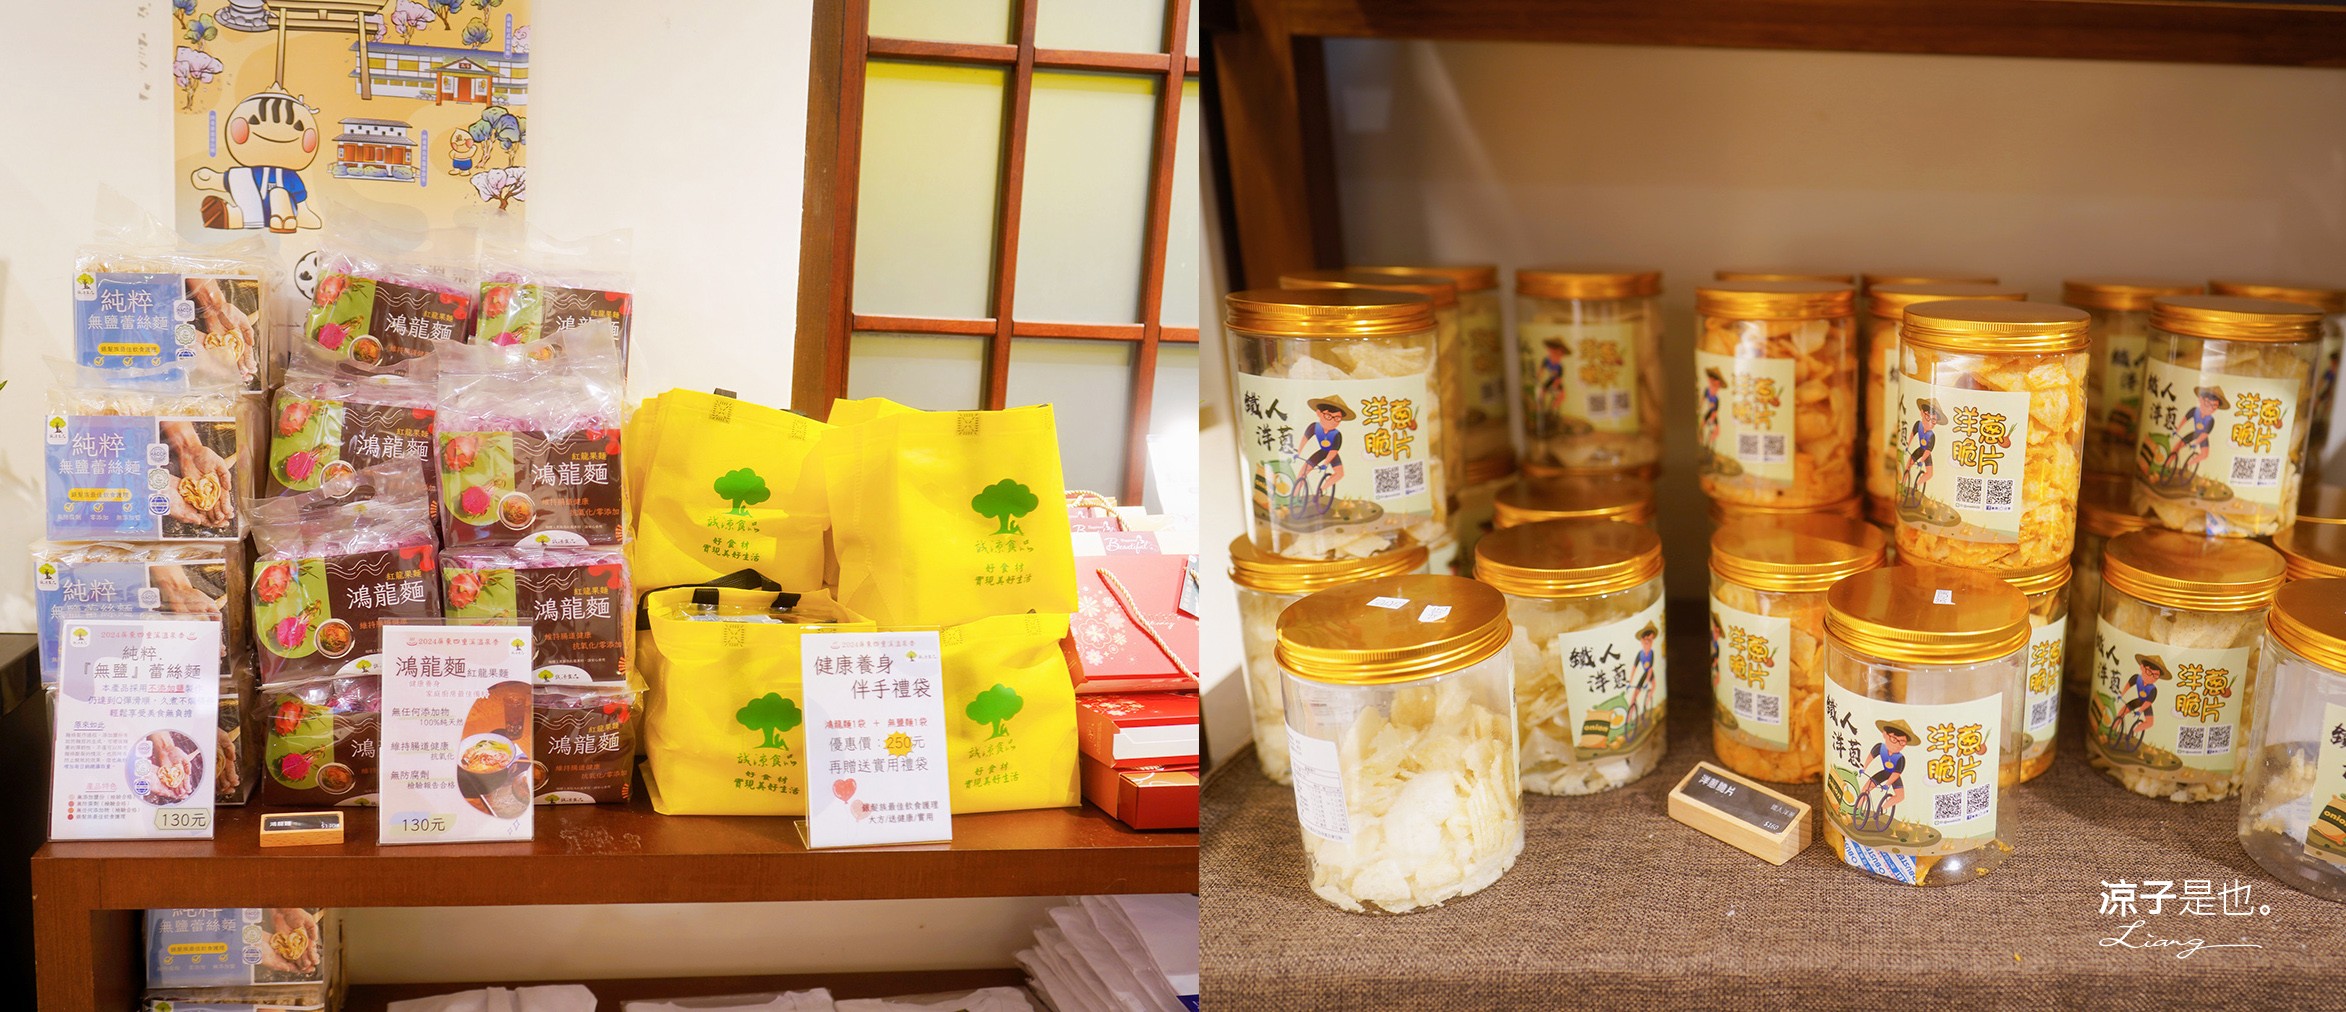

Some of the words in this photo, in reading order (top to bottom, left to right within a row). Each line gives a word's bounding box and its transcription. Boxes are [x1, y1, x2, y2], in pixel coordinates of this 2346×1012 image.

[101, 289, 153, 314] 純粹
[88, 315, 168, 330] 無鹽蕾絲麵
[385, 313, 453, 341] 鴻龍麵
[1361, 395, 1413, 431] 洋蔥
[2234, 392, 2282, 427] 洋蔥
[396, 428, 429, 439] 紅龍果麵
[1953, 406, 2007, 445] 洋蔥
[72, 432, 125, 458] 純粹
[1363, 427, 1414, 461] 脆片
[2231, 422, 2277, 453] 脆片
[356, 434, 429, 462] 鴻龍麵
[572, 452, 607, 462] 紅龍果麵
[1952, 438, 2004, 475] 脆片
[59, 459, 141, 475] 無鹽蕾絲麵
[531, 462, 609, 486] 鴻龍麵
[702, 543, 760, 562] 實現美好生活
[386, 569, 422, 581] 紅龍果麵
[974, 574, 1032, 586] 實現美好生活
[62, 579, 117, 602] 純粹
[346, 581, 426, 610] 鴻龍麵
[573, 586, 609, 596] 紅龍果麵
[534, 597, 611, 621] 鴻龍麵
[545, 632, 592, 641] 維持腸道健康
[1728, 625, 1769, 663] 洋蔥
[395, 655, 466, 678] 鴻龍麵
[467, 668, 509, 678] 紅龍果麵
[814, 653, 894, 675] 健康養身
[1729, 653, 1769, 690] 脆片
[851, 678, 932, 699] 伴手禮袋
[2176, 663, 2229, 697] 洋蔥
[391, 707, 450, 717] 無任何添加物
[2175, 692, 2225, 723] 脆片
[419, 718, 464, 727] 100%純天然
[588, 722, 619, 734] 紅龍果麵
[824, 720, 867, 730] 鴻龍麵1袋
[1583, 723, 1609, 733] onion
[391, 741, 449, 752] 維持腸道健康
[548, 732, 620, 756] 鴻龍麵
[1926, 722, 1983, 758] 洋蔥
[430, 752, 455, 761] 抗氧化
[828, 757, 929, 774] 再贈送實用禮袋
[390, 770, 430, 781] 無防腐劑
[1927, 753, 1982, 787] 脆片
[407, 781, 456, 790] 檢驗報告合格
[733, 777, 800, 796] 實現美好生活
[964, 771, 1020, 790] 實現美好生活
[1698, 773, 1736, 797] 洋蔥脆片
[862, 801, 939, 812] 銀髮族最佳飲食護理
[162, 813, 206, 828] 130元
[402, 817, 446, 832] 130元
[869, 813, 934, 824] 大方/送健康/實用
[158, 918, 237, 934] 無鹽蕾絲麵
